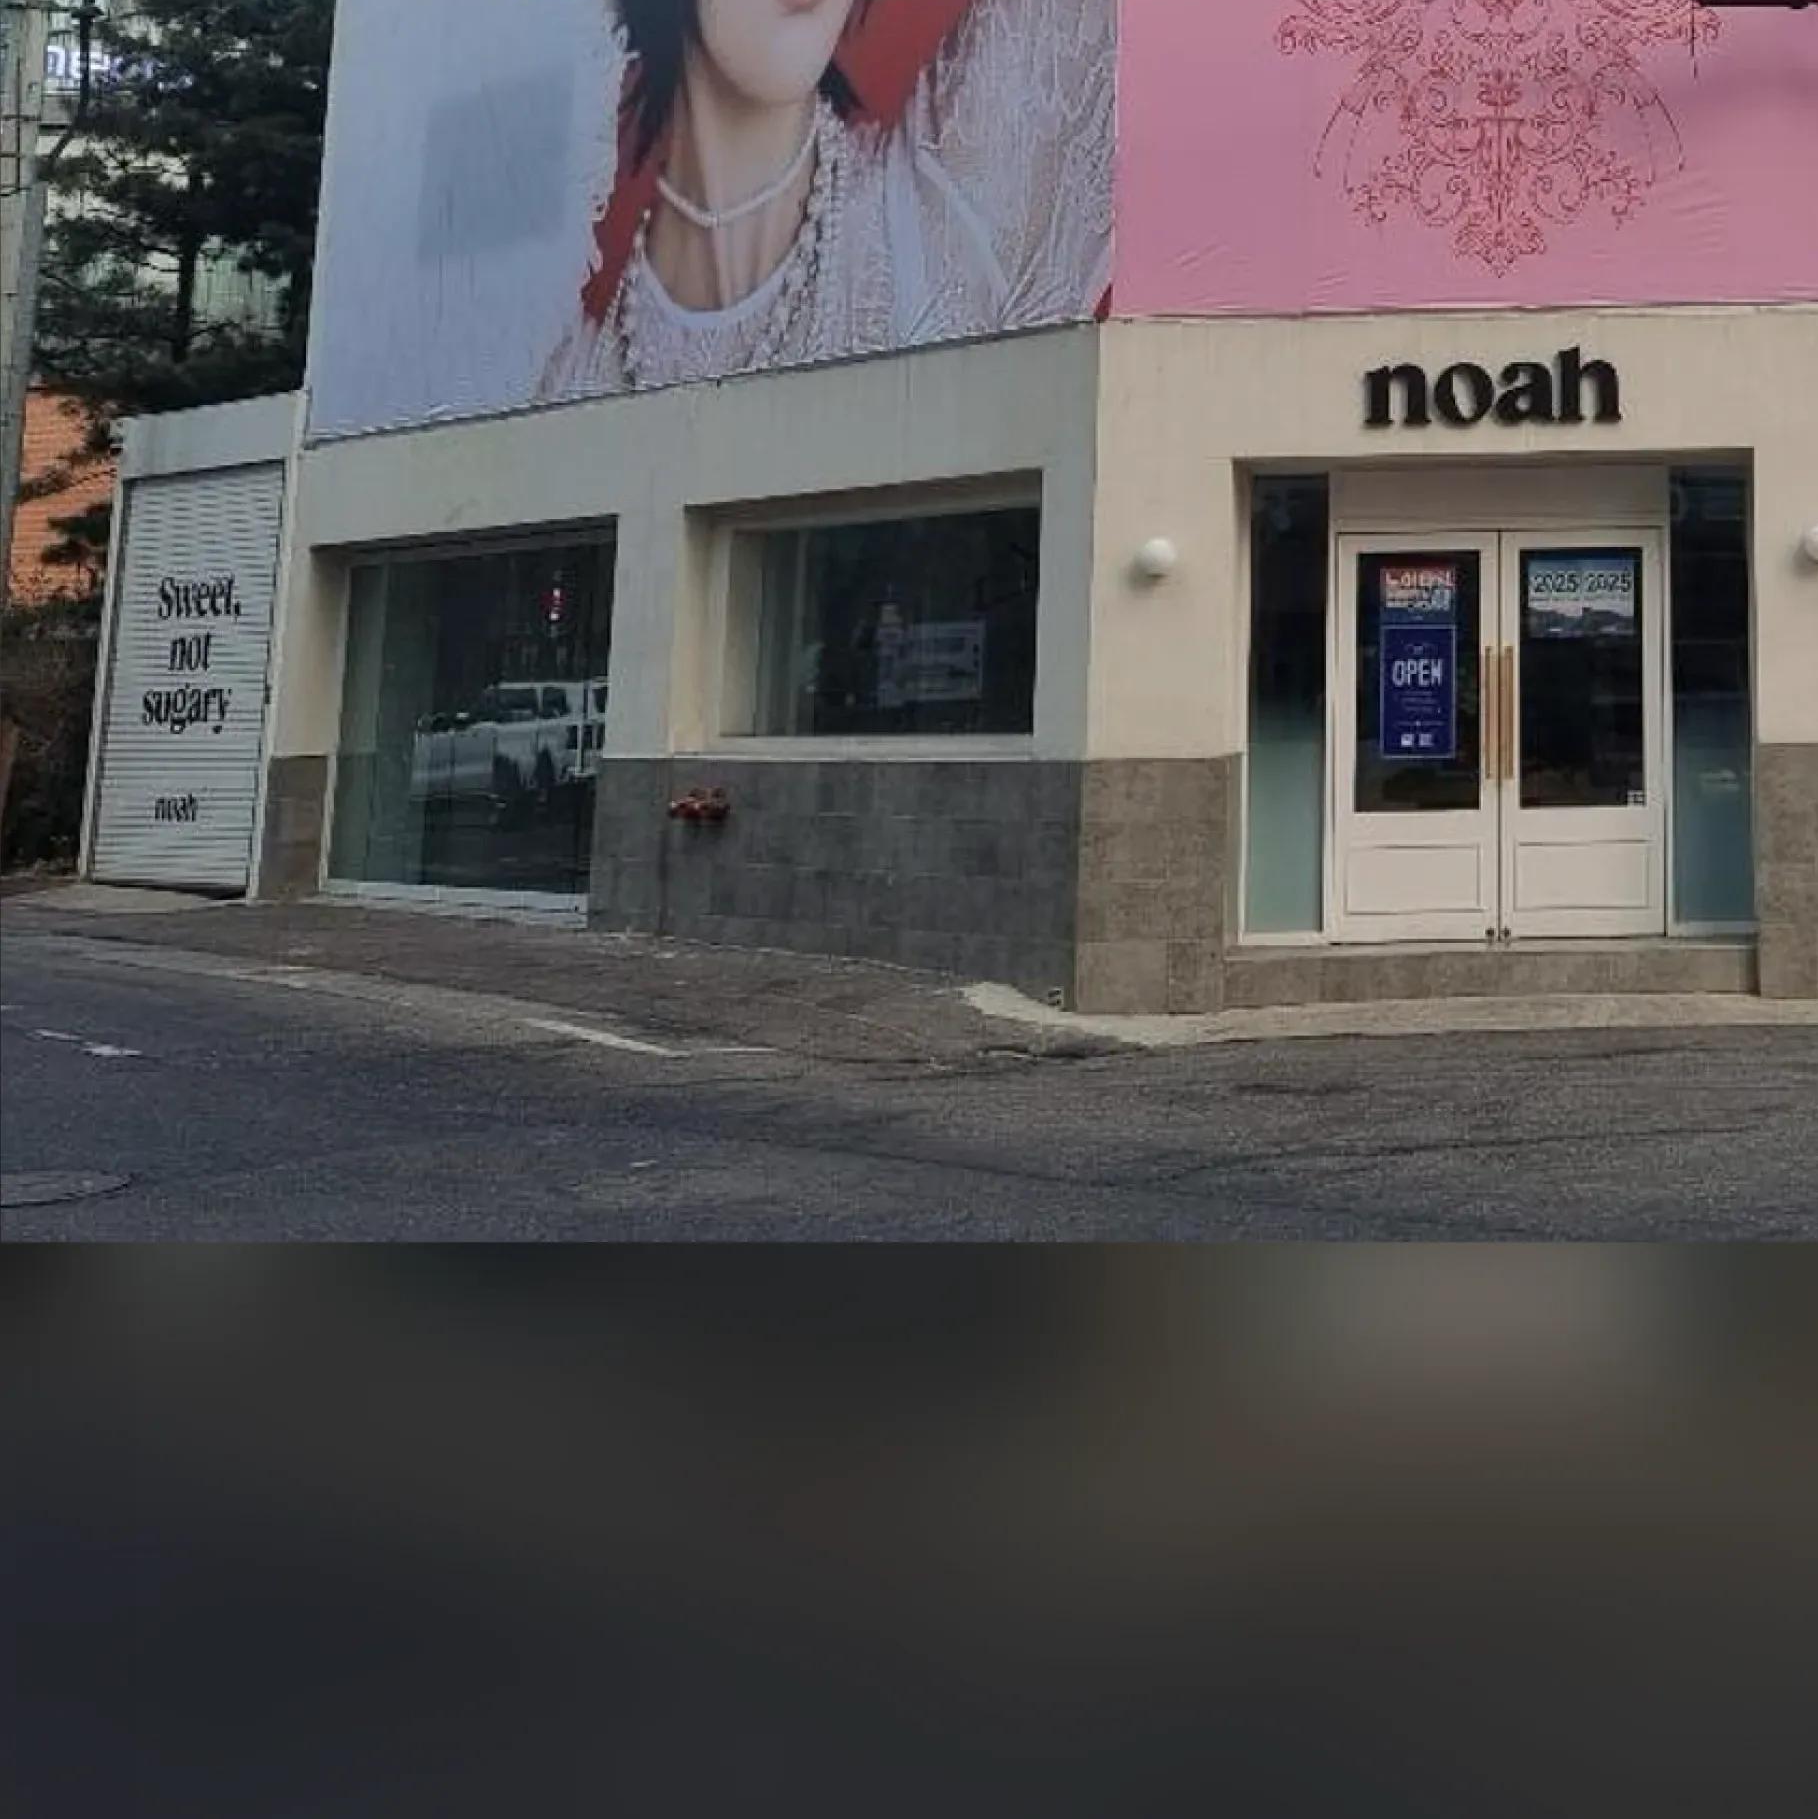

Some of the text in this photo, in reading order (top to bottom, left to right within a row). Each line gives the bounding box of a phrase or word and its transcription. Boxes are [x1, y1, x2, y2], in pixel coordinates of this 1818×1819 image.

[1363, 345, 1623, 425] noah
[157, 573, 242, 622] Sweet,
[168, 631, 213, 672] not
[1392, 657, 1444, 687] OPEN
[141, 682, 233, 734] sugary
